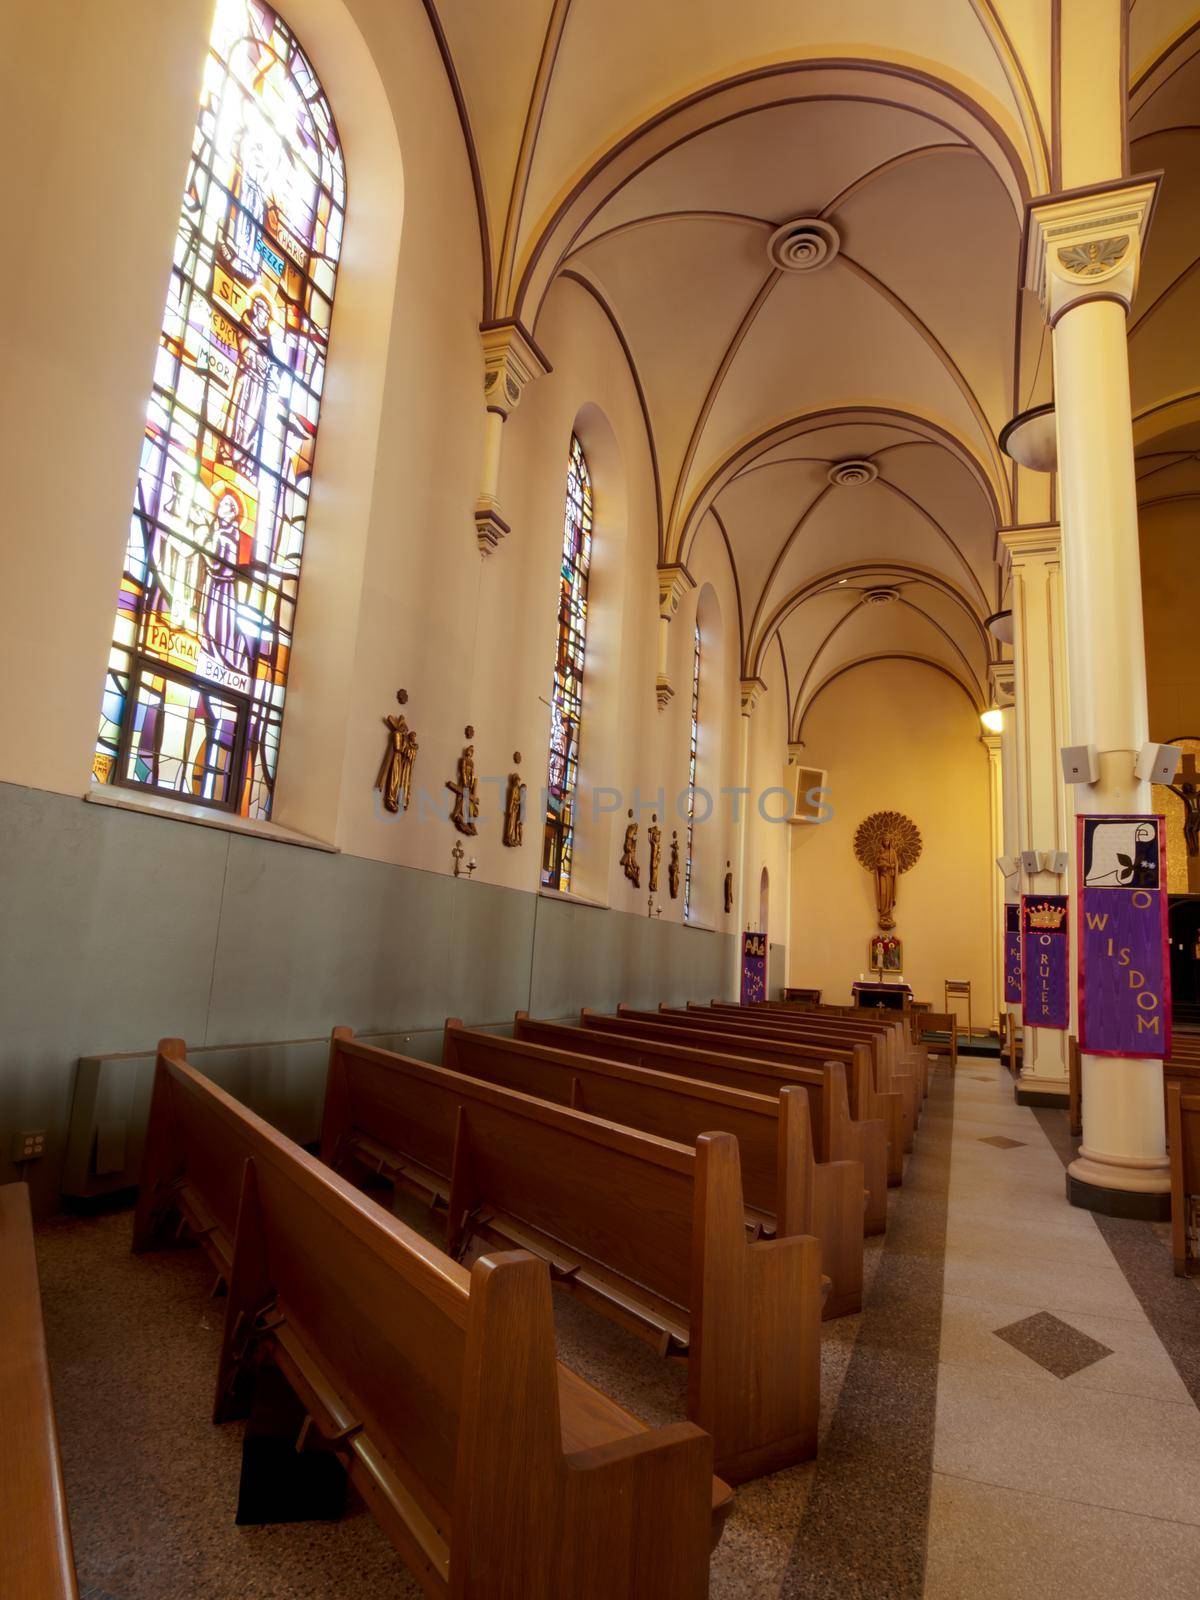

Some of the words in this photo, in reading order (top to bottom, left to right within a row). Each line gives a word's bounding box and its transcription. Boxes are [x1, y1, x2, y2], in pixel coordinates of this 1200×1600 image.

[255, 239, 285, 276] SEZZE
[220, 281, 242, 304] ST
[200, 347, 230, 380] MOOR
[152, 626, 198, 661] PASCHAL
[1132, 891, 1152, 909] O
[1040, 935, 1051, 946] O
[1040, 953, 1050, 1016] RULER
[1085, 912, 1160, 1035] WISDOM
